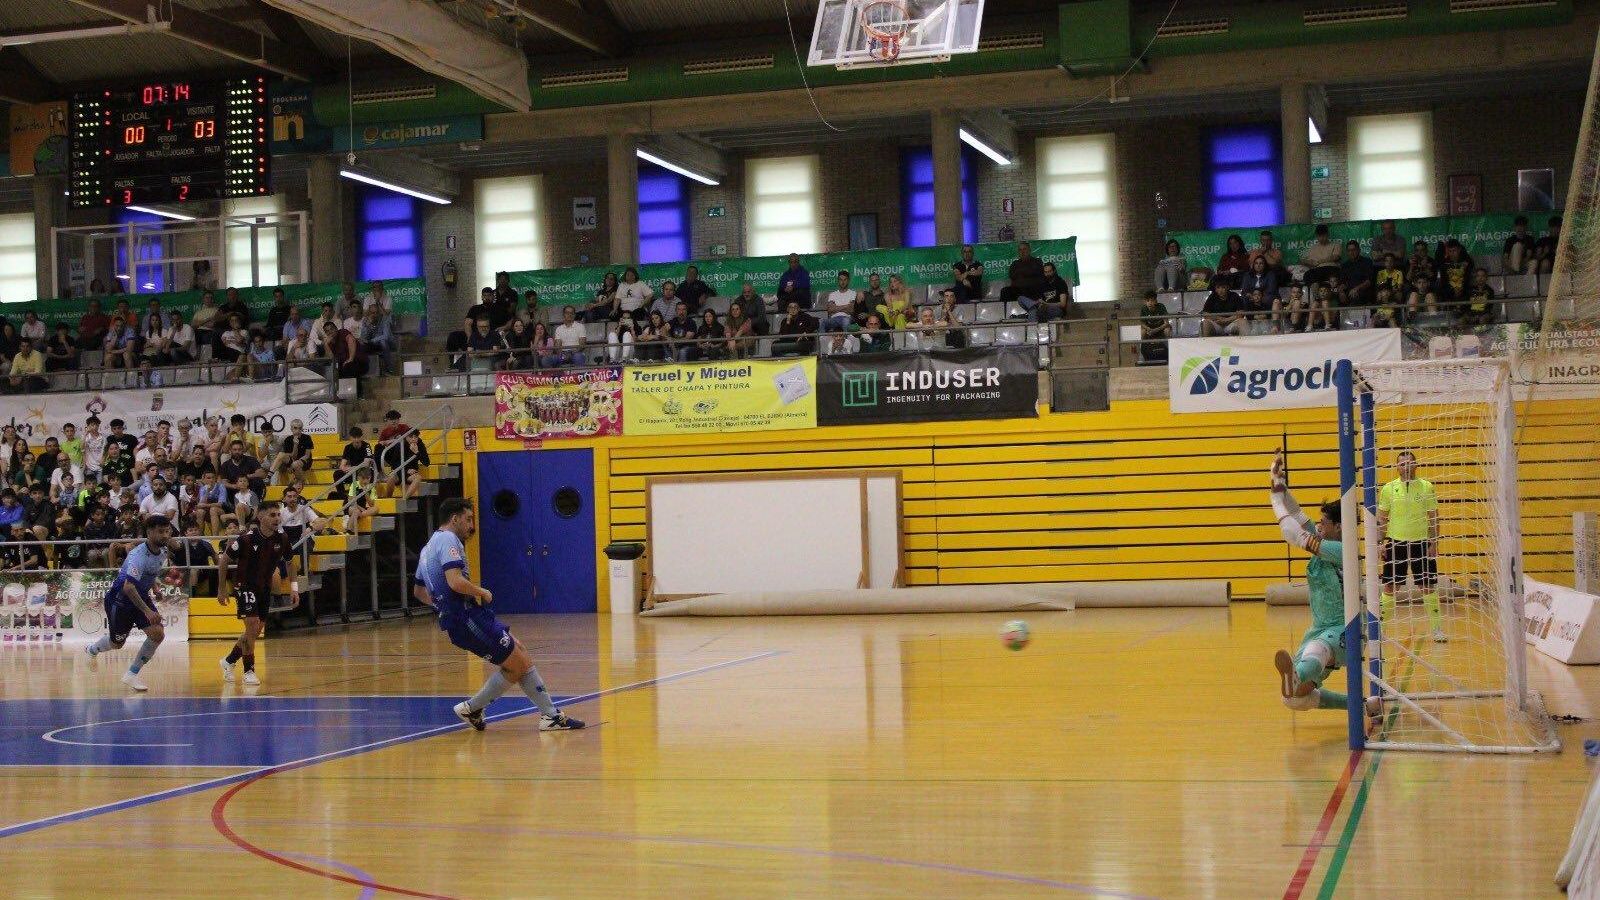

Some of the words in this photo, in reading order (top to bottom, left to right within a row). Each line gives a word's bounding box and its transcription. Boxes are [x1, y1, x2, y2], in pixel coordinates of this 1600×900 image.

[143, 85, 189, 104] 07:14
[122, 111, 150, 121] LOCAL
[186, 105, 214, 115] VISITANTE
[167, 119, 172, 131] 1
[195, 121, 214, 138] 03
[126, 126, 144, 144] 00
[381, 123, 449, 141] cajamar
[114, 152, 139, 160] JUGADOR
[171, 175, 191, 184] FALTAS
[124, 190, 131, 203] 3
[180, 186, 188, 199] 2
[854, 264, 905, 276] INAGROUP
[501, 374, 526, 386] CLUB
[526, 375, 575, 386] GIMNASIA
[632, 369, 681, 382] Teruel
[686, 371, 695, 382] y
[700, 366, 752, 380] Miguel
[886, 367, 1000, 391] INDUSER
[714, 382, 751, 391] PINTURA
[886, 394, 931, 403] INGENUITY
[936, 393, 950, 401] FOR
[955, 391, 1000, 400] PACKAGING
[243, 591, 256, 603] 13
